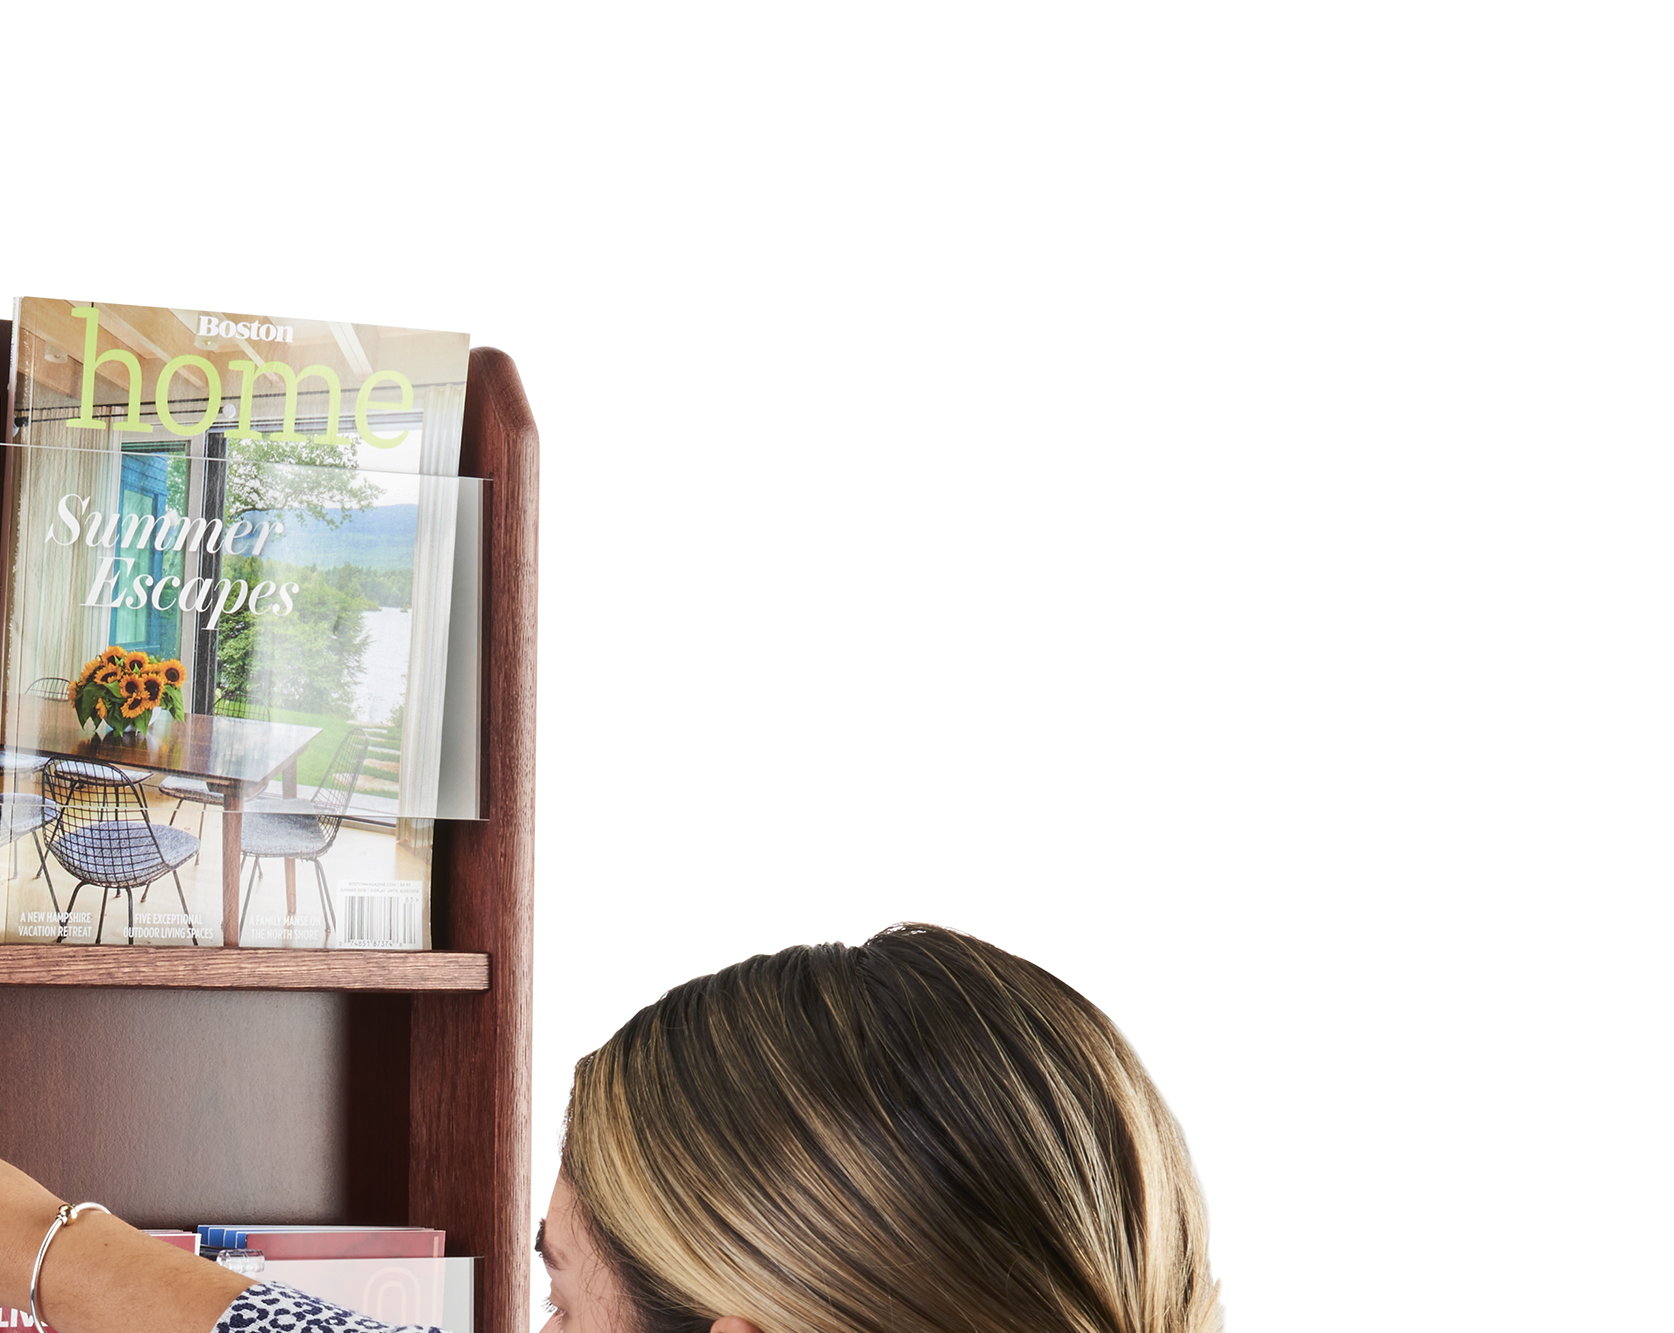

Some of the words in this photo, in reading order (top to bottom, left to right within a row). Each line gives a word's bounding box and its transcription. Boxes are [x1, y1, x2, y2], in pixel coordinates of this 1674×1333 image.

[198, 315, 294, 343] Boston
[66, 307, 414, 449] home
[45, 494, 283, 557] Summer
[79, 556, 300, 630] Escapes
